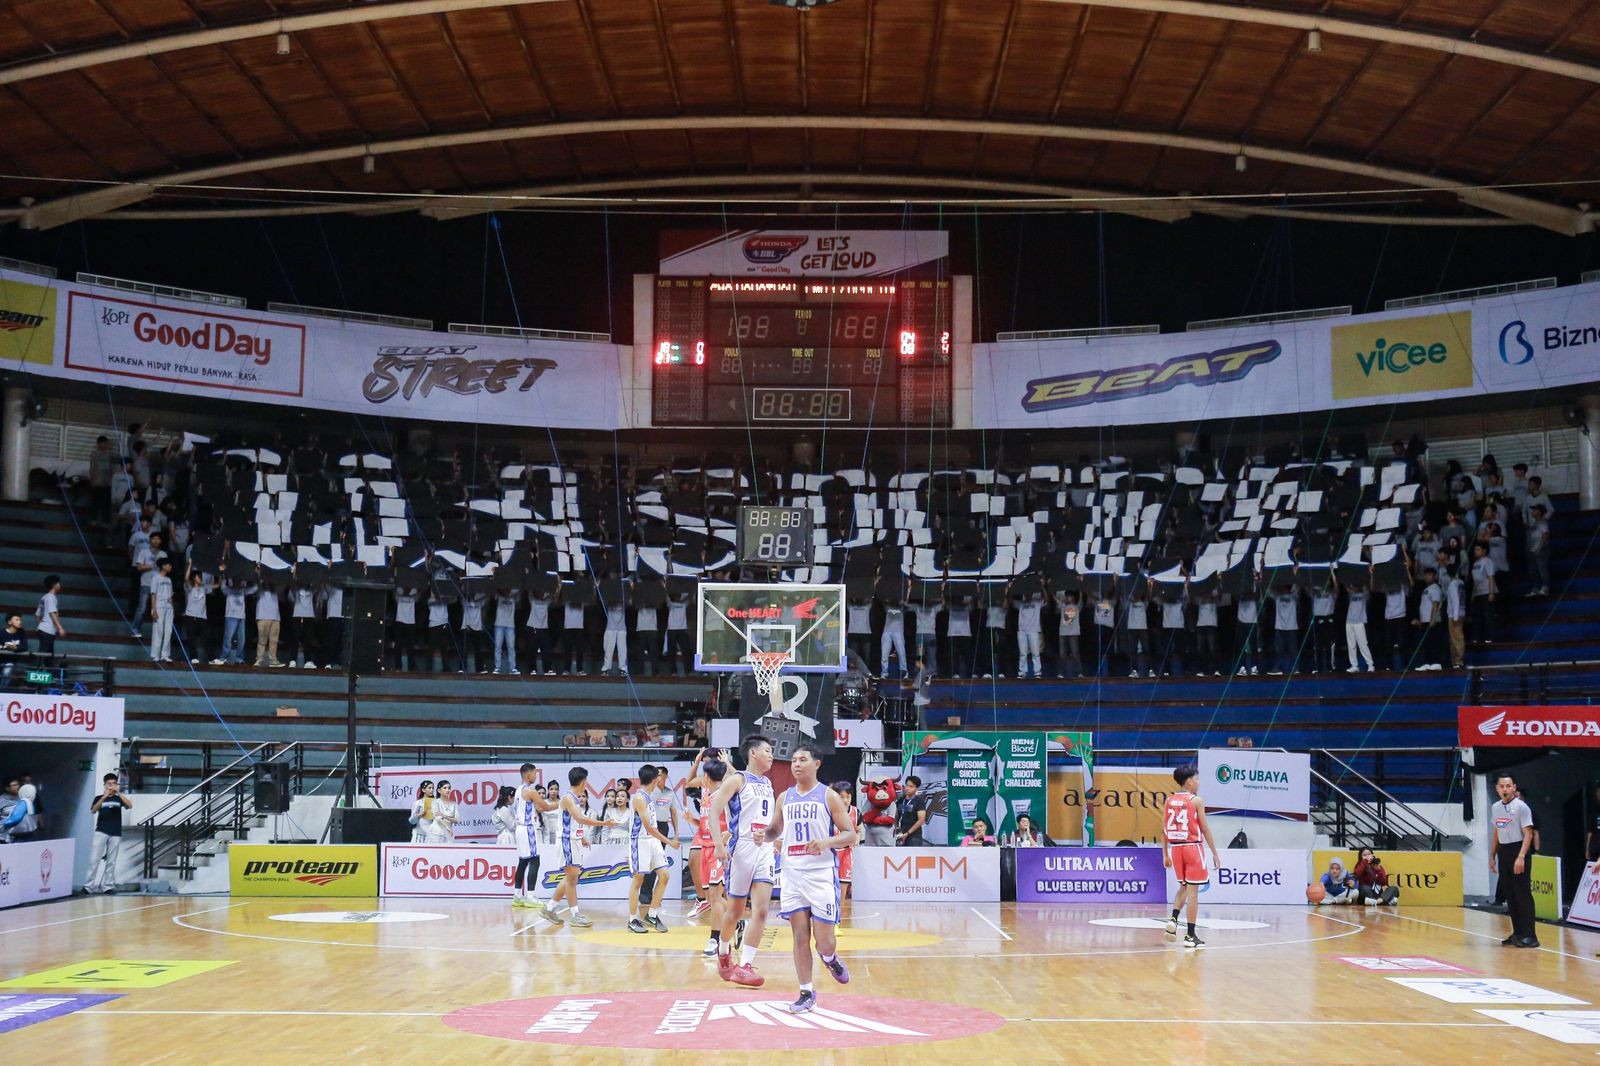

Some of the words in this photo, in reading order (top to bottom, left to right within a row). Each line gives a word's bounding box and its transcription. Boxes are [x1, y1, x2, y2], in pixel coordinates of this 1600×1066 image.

[817, 236, 850, 251] LET'S
[801, 254, 832, 270] GET
[831, 251, 877, 272] LOUD
[795, 310, 812, 319] PERIOD
[133, 311, 211, 350] Good
[214, 323, 271, 366] Day
[1544, 325, 1600, 350] Bizn
[108, 354, 144, 368] KARENA
[147, 360, 172, 371] HIDUP
[174, 363, 199, 375] PERLU
[202, 366, 233, 379] BANYAK
[238, 373, 258, 382] RASA
[362, 356, 558, 404] STREET
[30, 672, 51, 682] EXIT
[6, 700, 57, 724] Good
[60, 702, 96, 731] Day
[1505, 720, 1600, 736] HONDA
[953, 760, 987, 769] AWESOME
[1007, 760, 1041, 769] AWESOME
[959, 770, 981, 778] SHOOT
[1012, 770, 1035, 778] SHOOT
[1233, 769, 1246, 781] RS
[1249, 769, 1289, 783] UBAYA
[951, 779, 989, 787] CHALLENGE
[1005, 779, 1042, 787] CHALLENGE
[762, 799, 769, 817] 9
[787, 803, 818, 819] HASA
[1167, 809, 1189, 831] 24
[795, 822, 811, 842] 81
[243, 859, 360, 877] proteam
[412, 857, 470, 880] Good
[473, 858, 517, 887] Day
[883, 856, 967, 879] MPM
[1044, 857, 1092, 871] ULTRA
[1098, 857, 1134, 871] MILK
[1218, 868, 1281, 885] Biznet
[895, 886, 957, 894] DISTRIBUTOR
[1036, 880, 1104, 894] BLUEBERRY
[1107, 880, 1148, 893] BLAST
